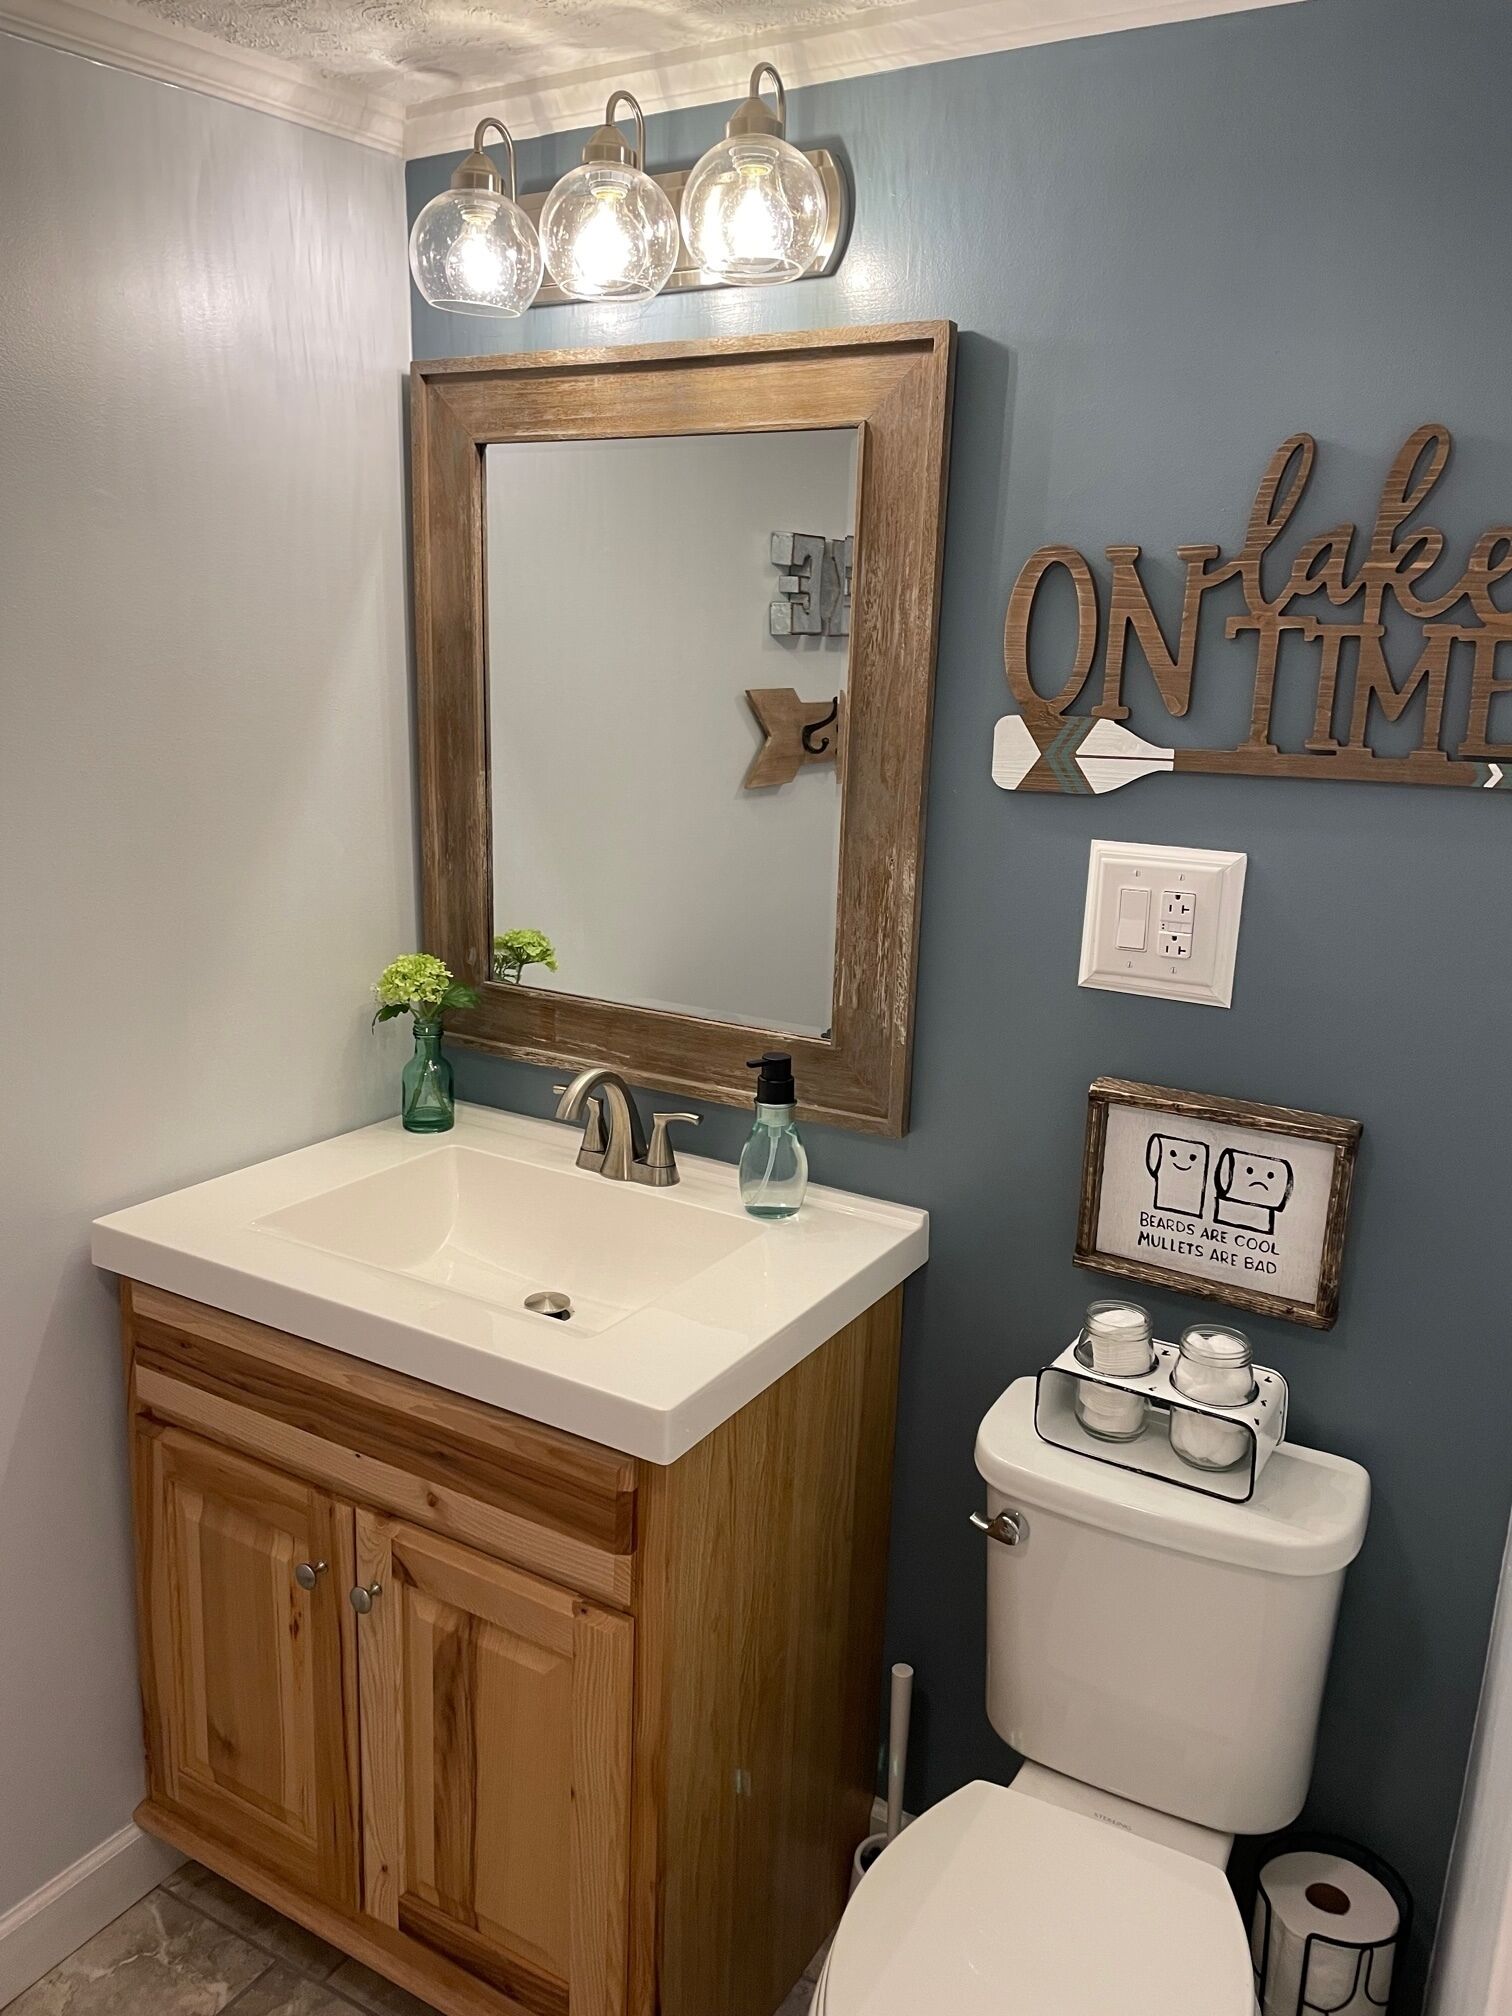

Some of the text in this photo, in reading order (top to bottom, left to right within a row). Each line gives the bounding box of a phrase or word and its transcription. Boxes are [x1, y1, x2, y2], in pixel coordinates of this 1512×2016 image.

[1004, 545, 1221, 721] ON
[1202, 423, 1512, 620] lake
[1225, 615, 1512, 762] TIME
[1138, 1231, 1277, 1275] MULLETS ARE BAD
[1140, 1211, 1280, 1256] BEARDS ARE COOL
